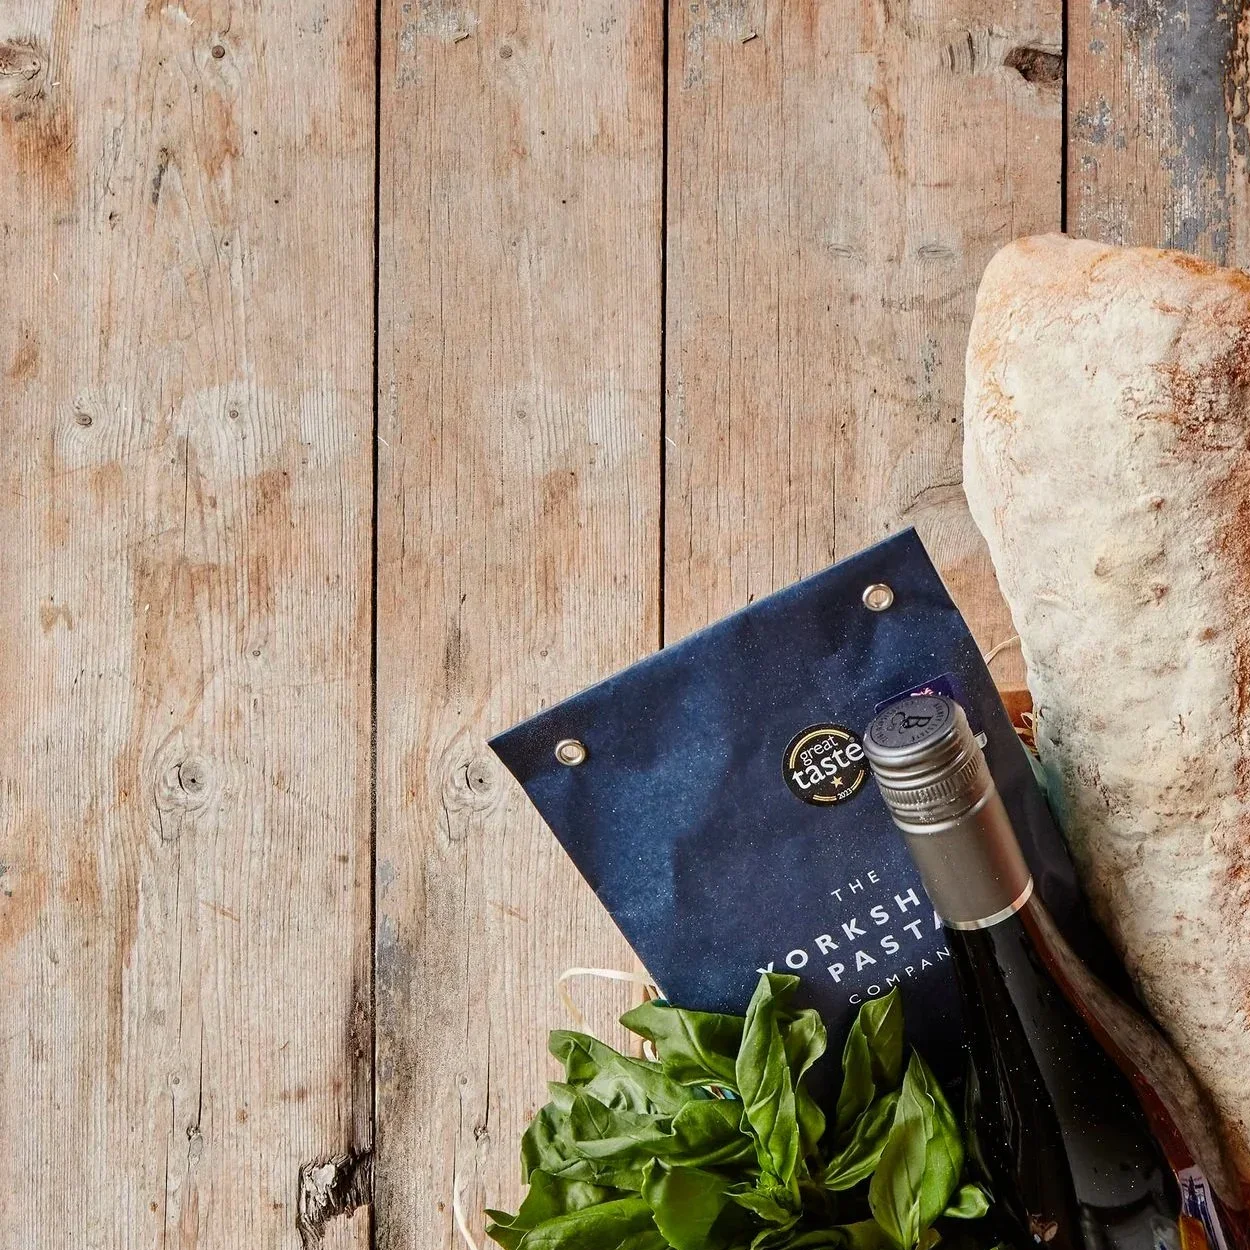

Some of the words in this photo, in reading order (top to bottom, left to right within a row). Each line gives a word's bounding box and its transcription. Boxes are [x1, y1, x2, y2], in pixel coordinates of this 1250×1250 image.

[792, 742, 864, 790] taste
[800, 735, 838, 766] great
[837, 788, 852, 800] 2023
[831, 870, 880, 902] THE
